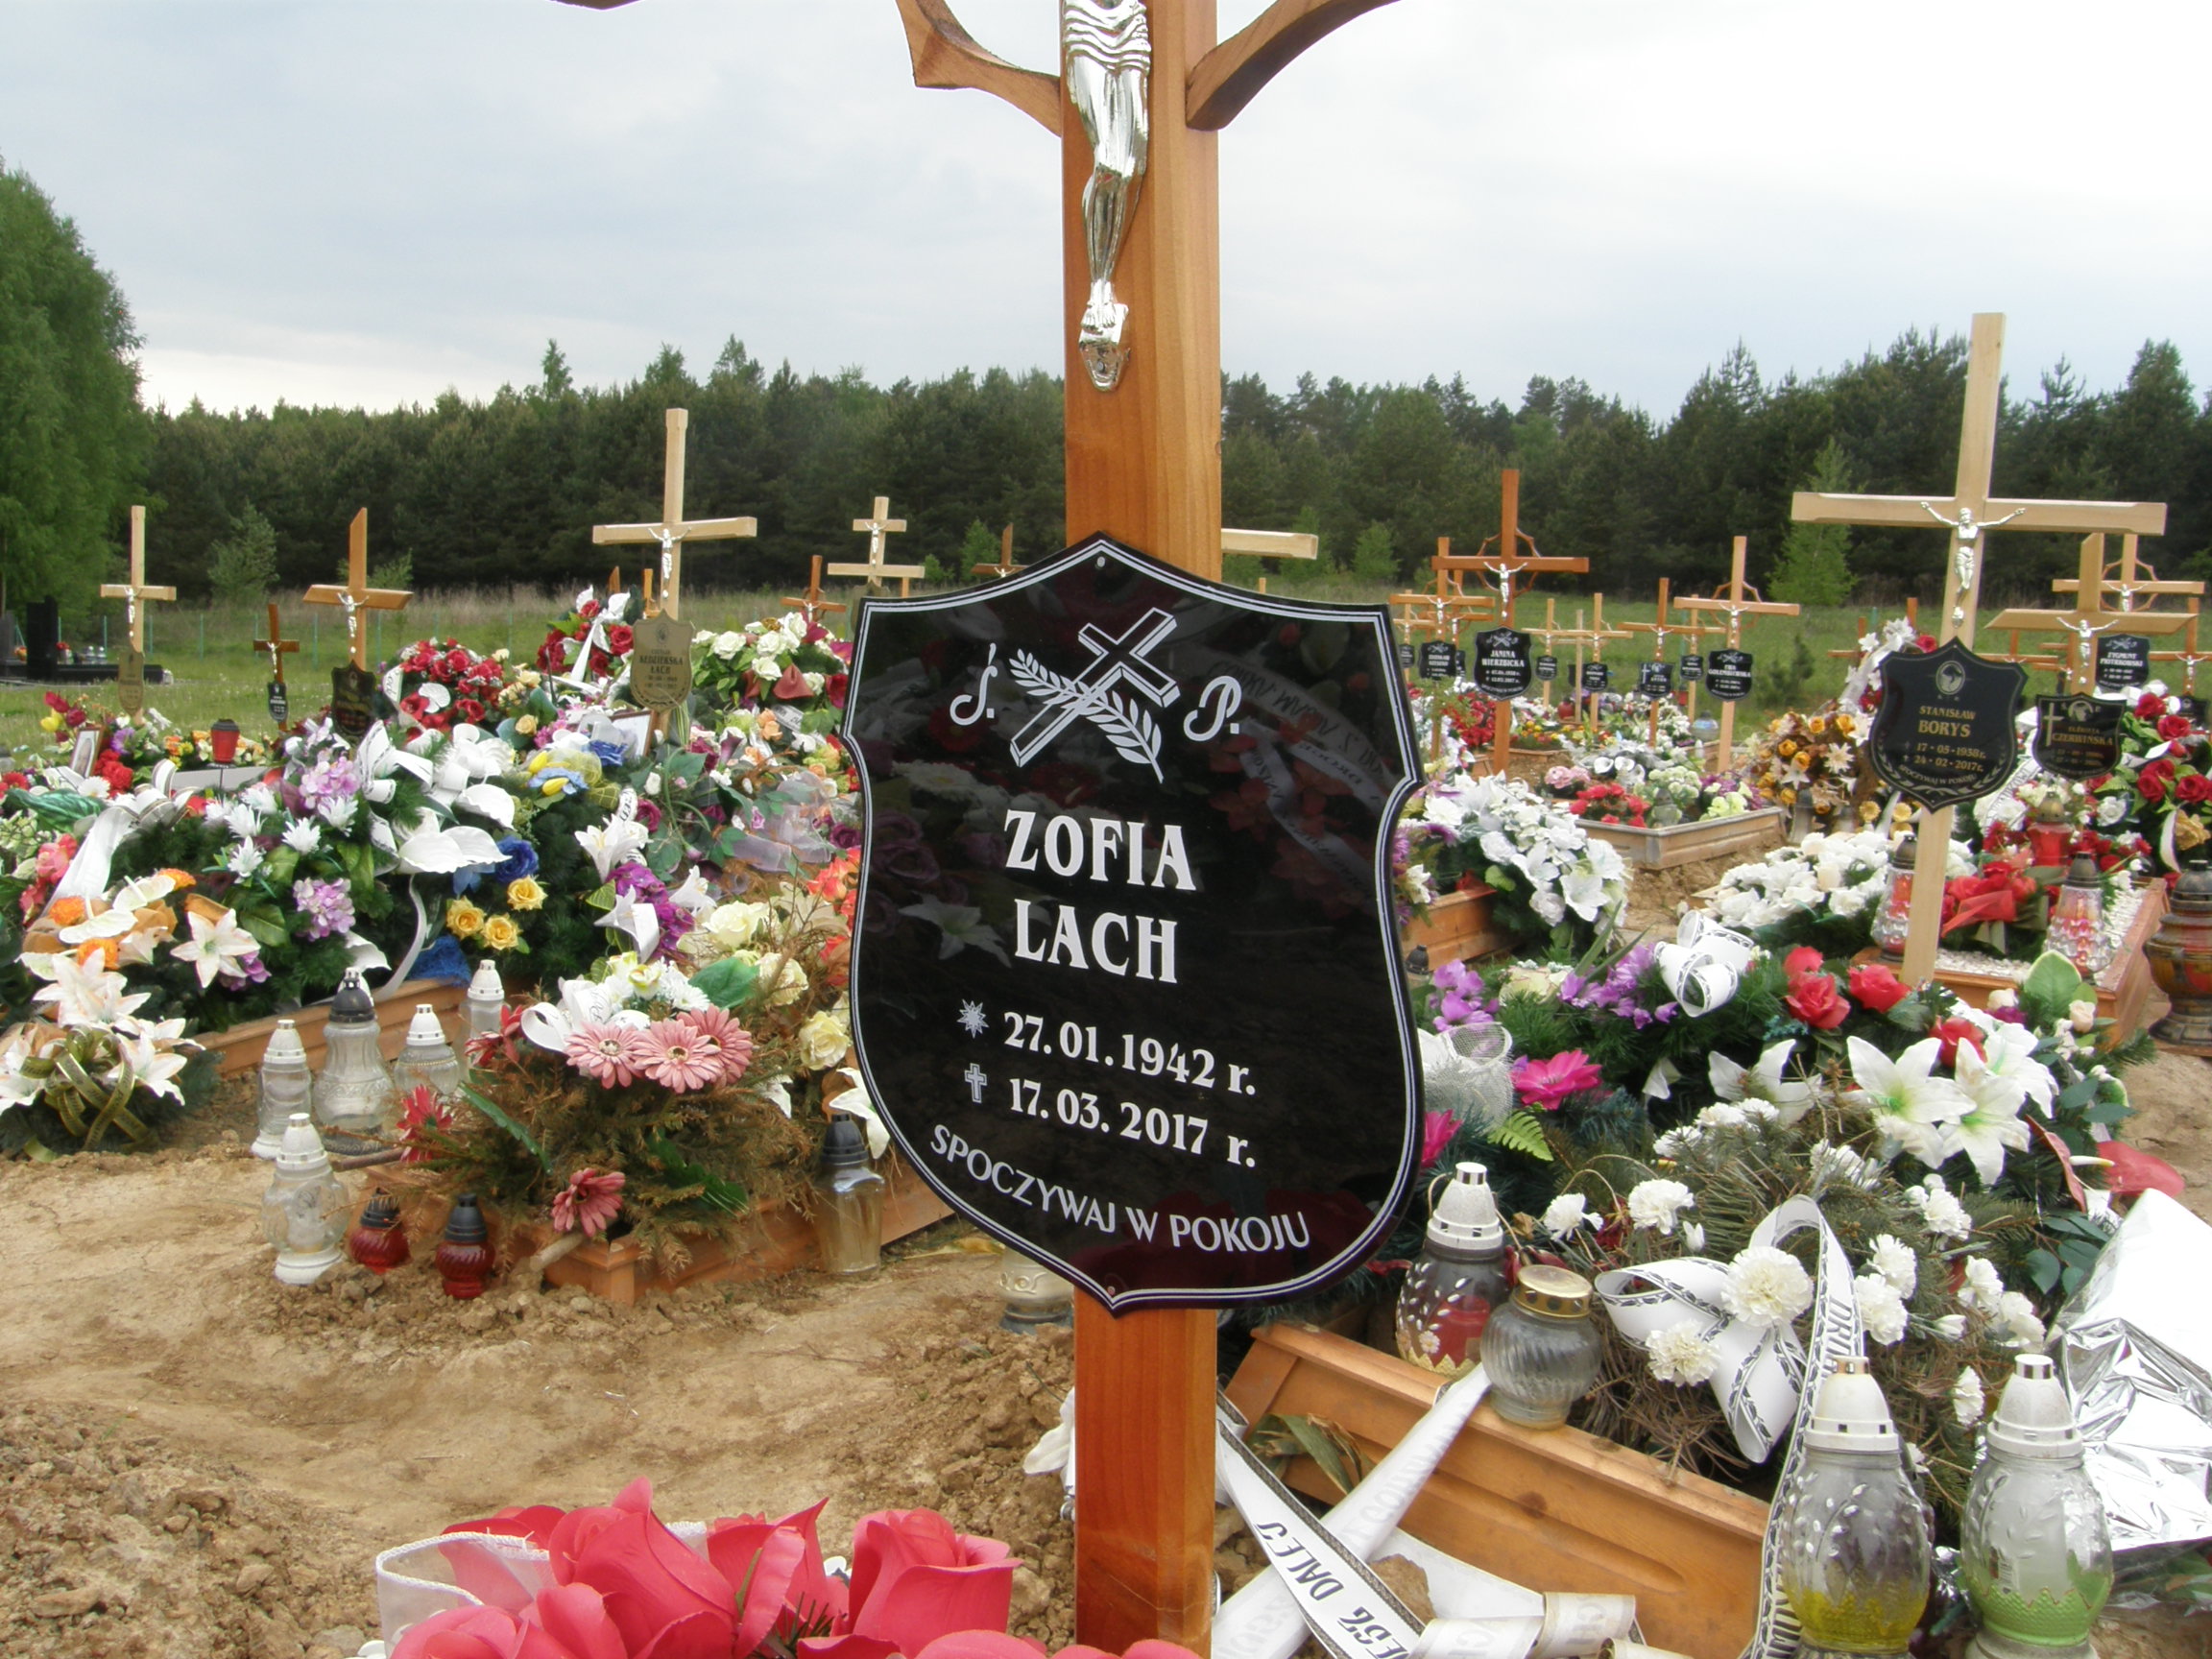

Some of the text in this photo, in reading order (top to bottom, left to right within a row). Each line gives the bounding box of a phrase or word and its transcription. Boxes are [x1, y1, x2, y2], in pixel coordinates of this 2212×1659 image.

[1918, 720, 1971, 738] BORYS
[1919, 705, 1977, 720] STANISŁAW
[1004, 809, 1196, 891] ZOFIA
[1015, 899, 1178, 984] LACH
[1229, 1065, 1256, 1095] r.
[1228, 1136, 1256, 1167] r.
[929, 1124, 1310, 1253] SPOCZYWAJ W POKOJU
[1255, 1522, 1345, 1601] DALEJ
